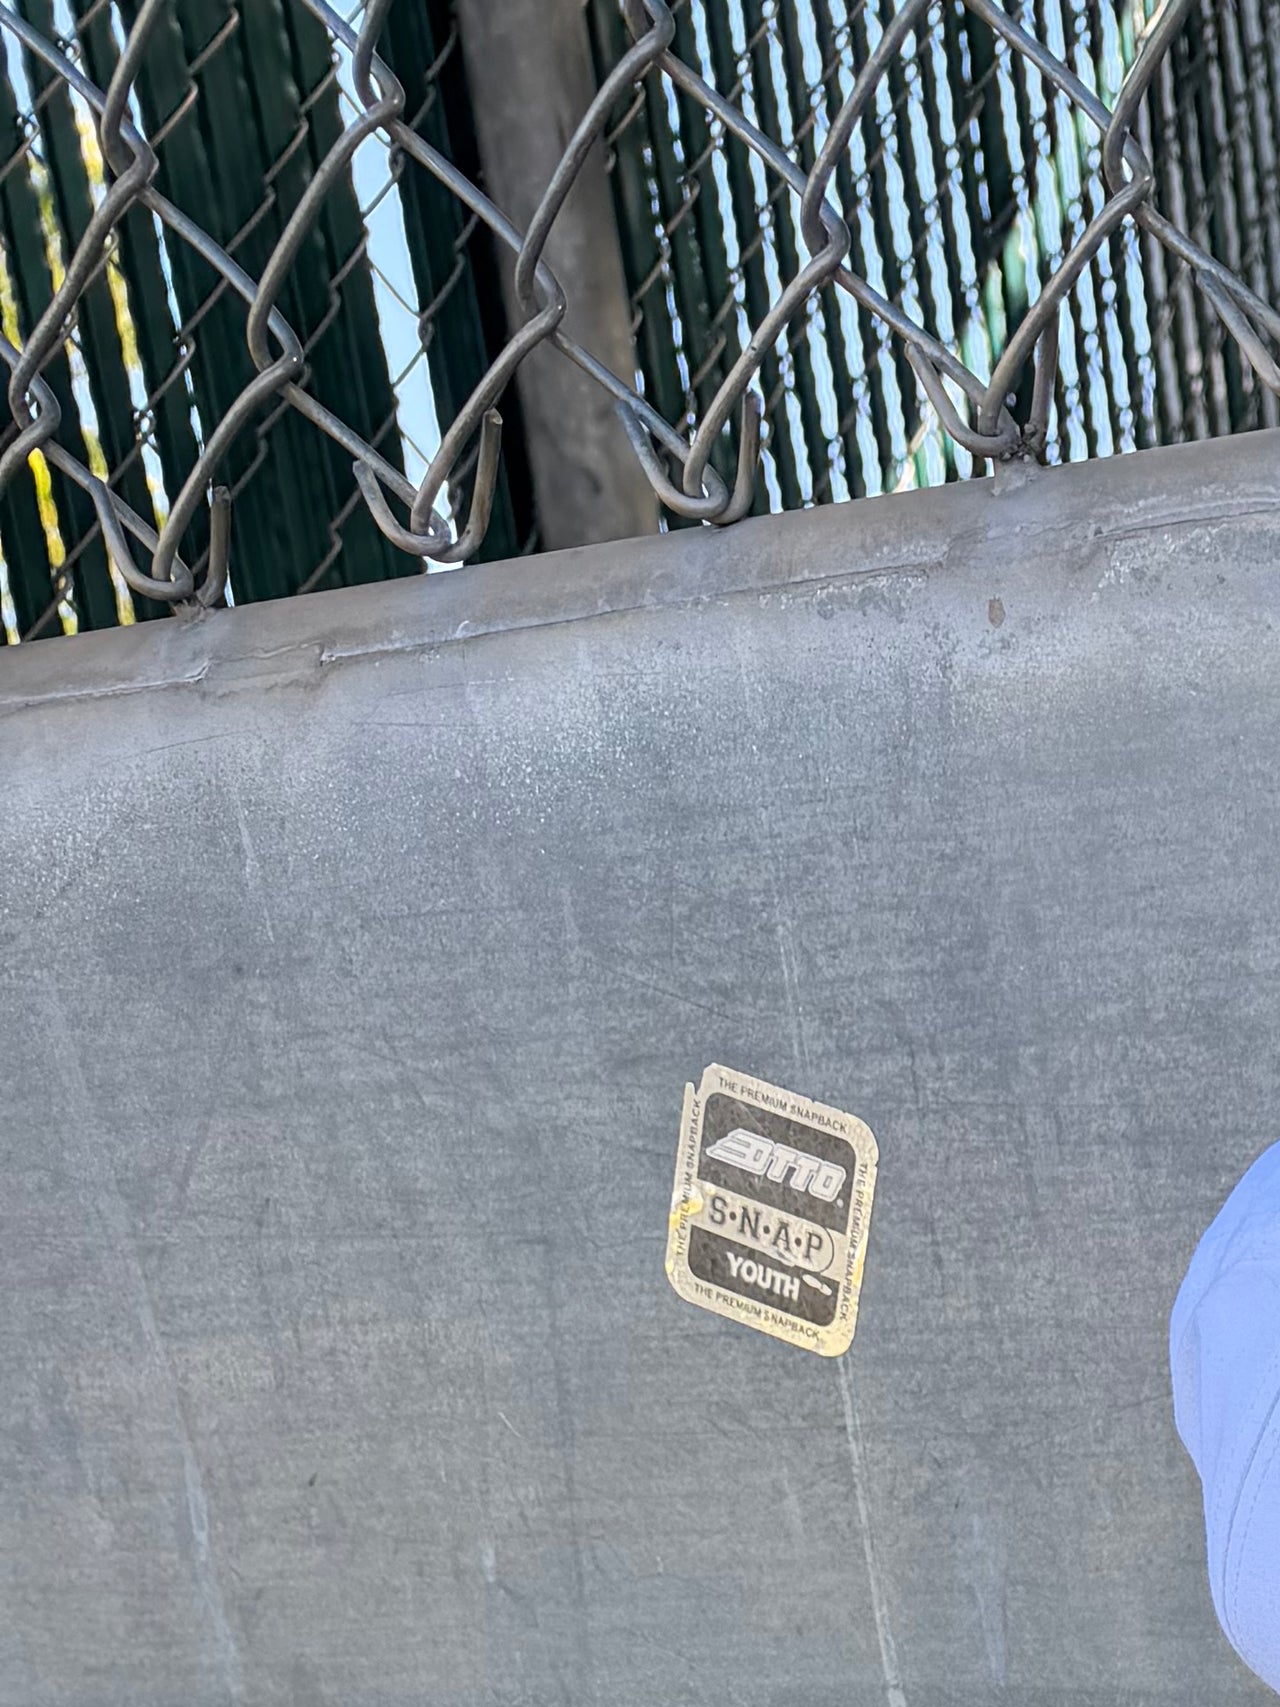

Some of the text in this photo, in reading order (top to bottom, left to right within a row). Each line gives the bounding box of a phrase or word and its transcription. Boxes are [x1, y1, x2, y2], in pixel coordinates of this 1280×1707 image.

[719, 1077, 847, 1133] THE PREMIUM SNAPBACK
[676, 1231, 687, 1256] THE
[686, 1099, 701, 1168] SNAPBACK
[705, 1128, 846, 1202] OTTO
[855, 1163, 868, 1187] THE
[726, 1251, 800, 1301] YOUTH
[694, 1282, 819, 1340] THE PREMIUM SNAPBACK
